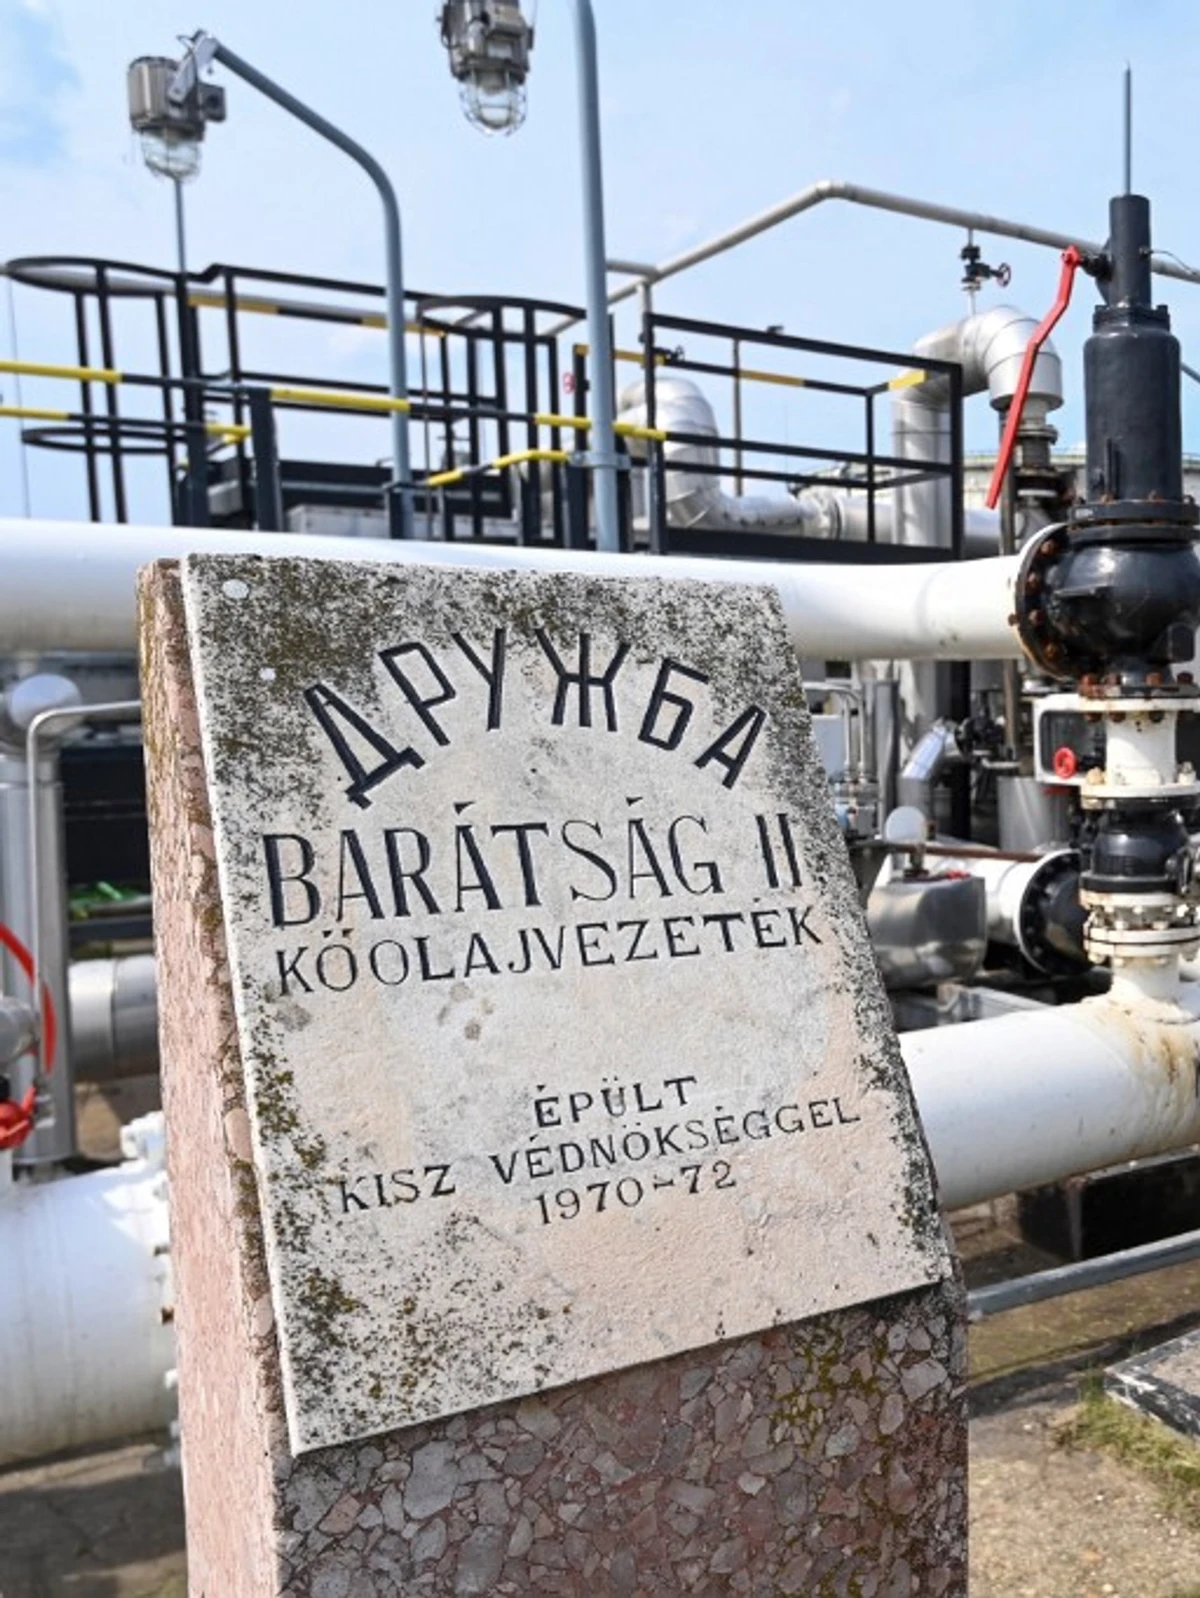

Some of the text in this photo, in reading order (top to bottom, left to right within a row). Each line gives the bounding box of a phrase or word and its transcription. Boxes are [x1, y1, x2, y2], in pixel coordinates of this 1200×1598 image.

[304, 627, 767, 809] ДРУЖБА
[263, 797, 803, 928] BARÁTSÁG II
[276, 898, 823, 997] KŐOLAJVEZETÉK
[339, 1097, 861, 1213] KISZ VÉDNÖKSÉGGEL
[534, 1075, 698, 1129] ÉPÜLT
[534, 1160, 737, 1225] 1970-72
